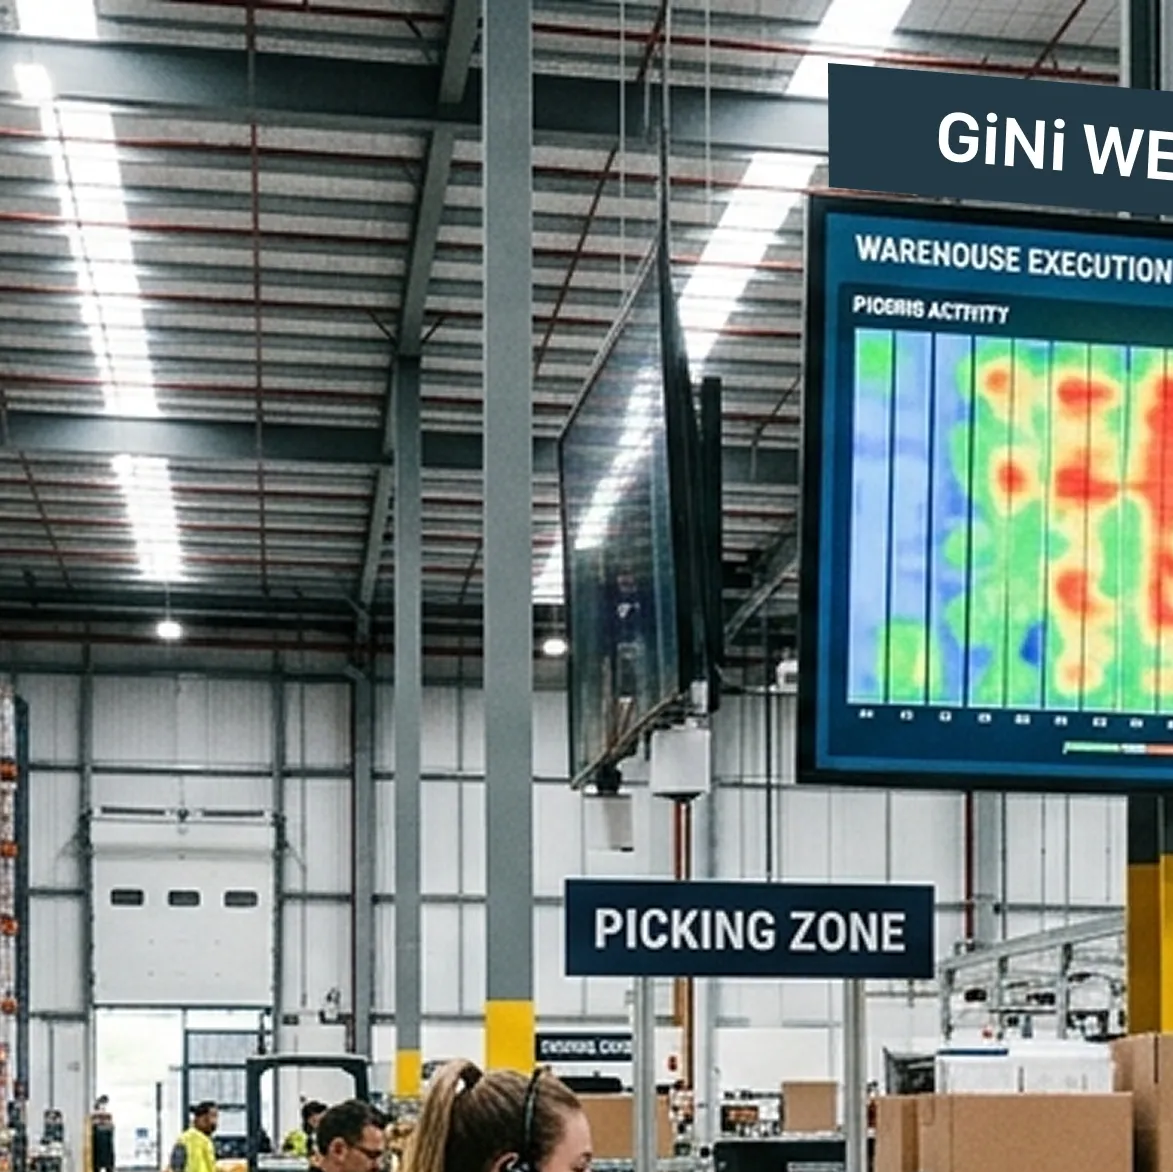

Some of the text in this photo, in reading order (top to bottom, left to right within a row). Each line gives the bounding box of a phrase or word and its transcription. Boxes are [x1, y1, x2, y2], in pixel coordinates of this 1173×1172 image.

[938, 111, 1066, 171] GiNi
[1028, 248, 1173, 285] EXECUTION
[595, 908, 906, 952] PICKING ZONE
